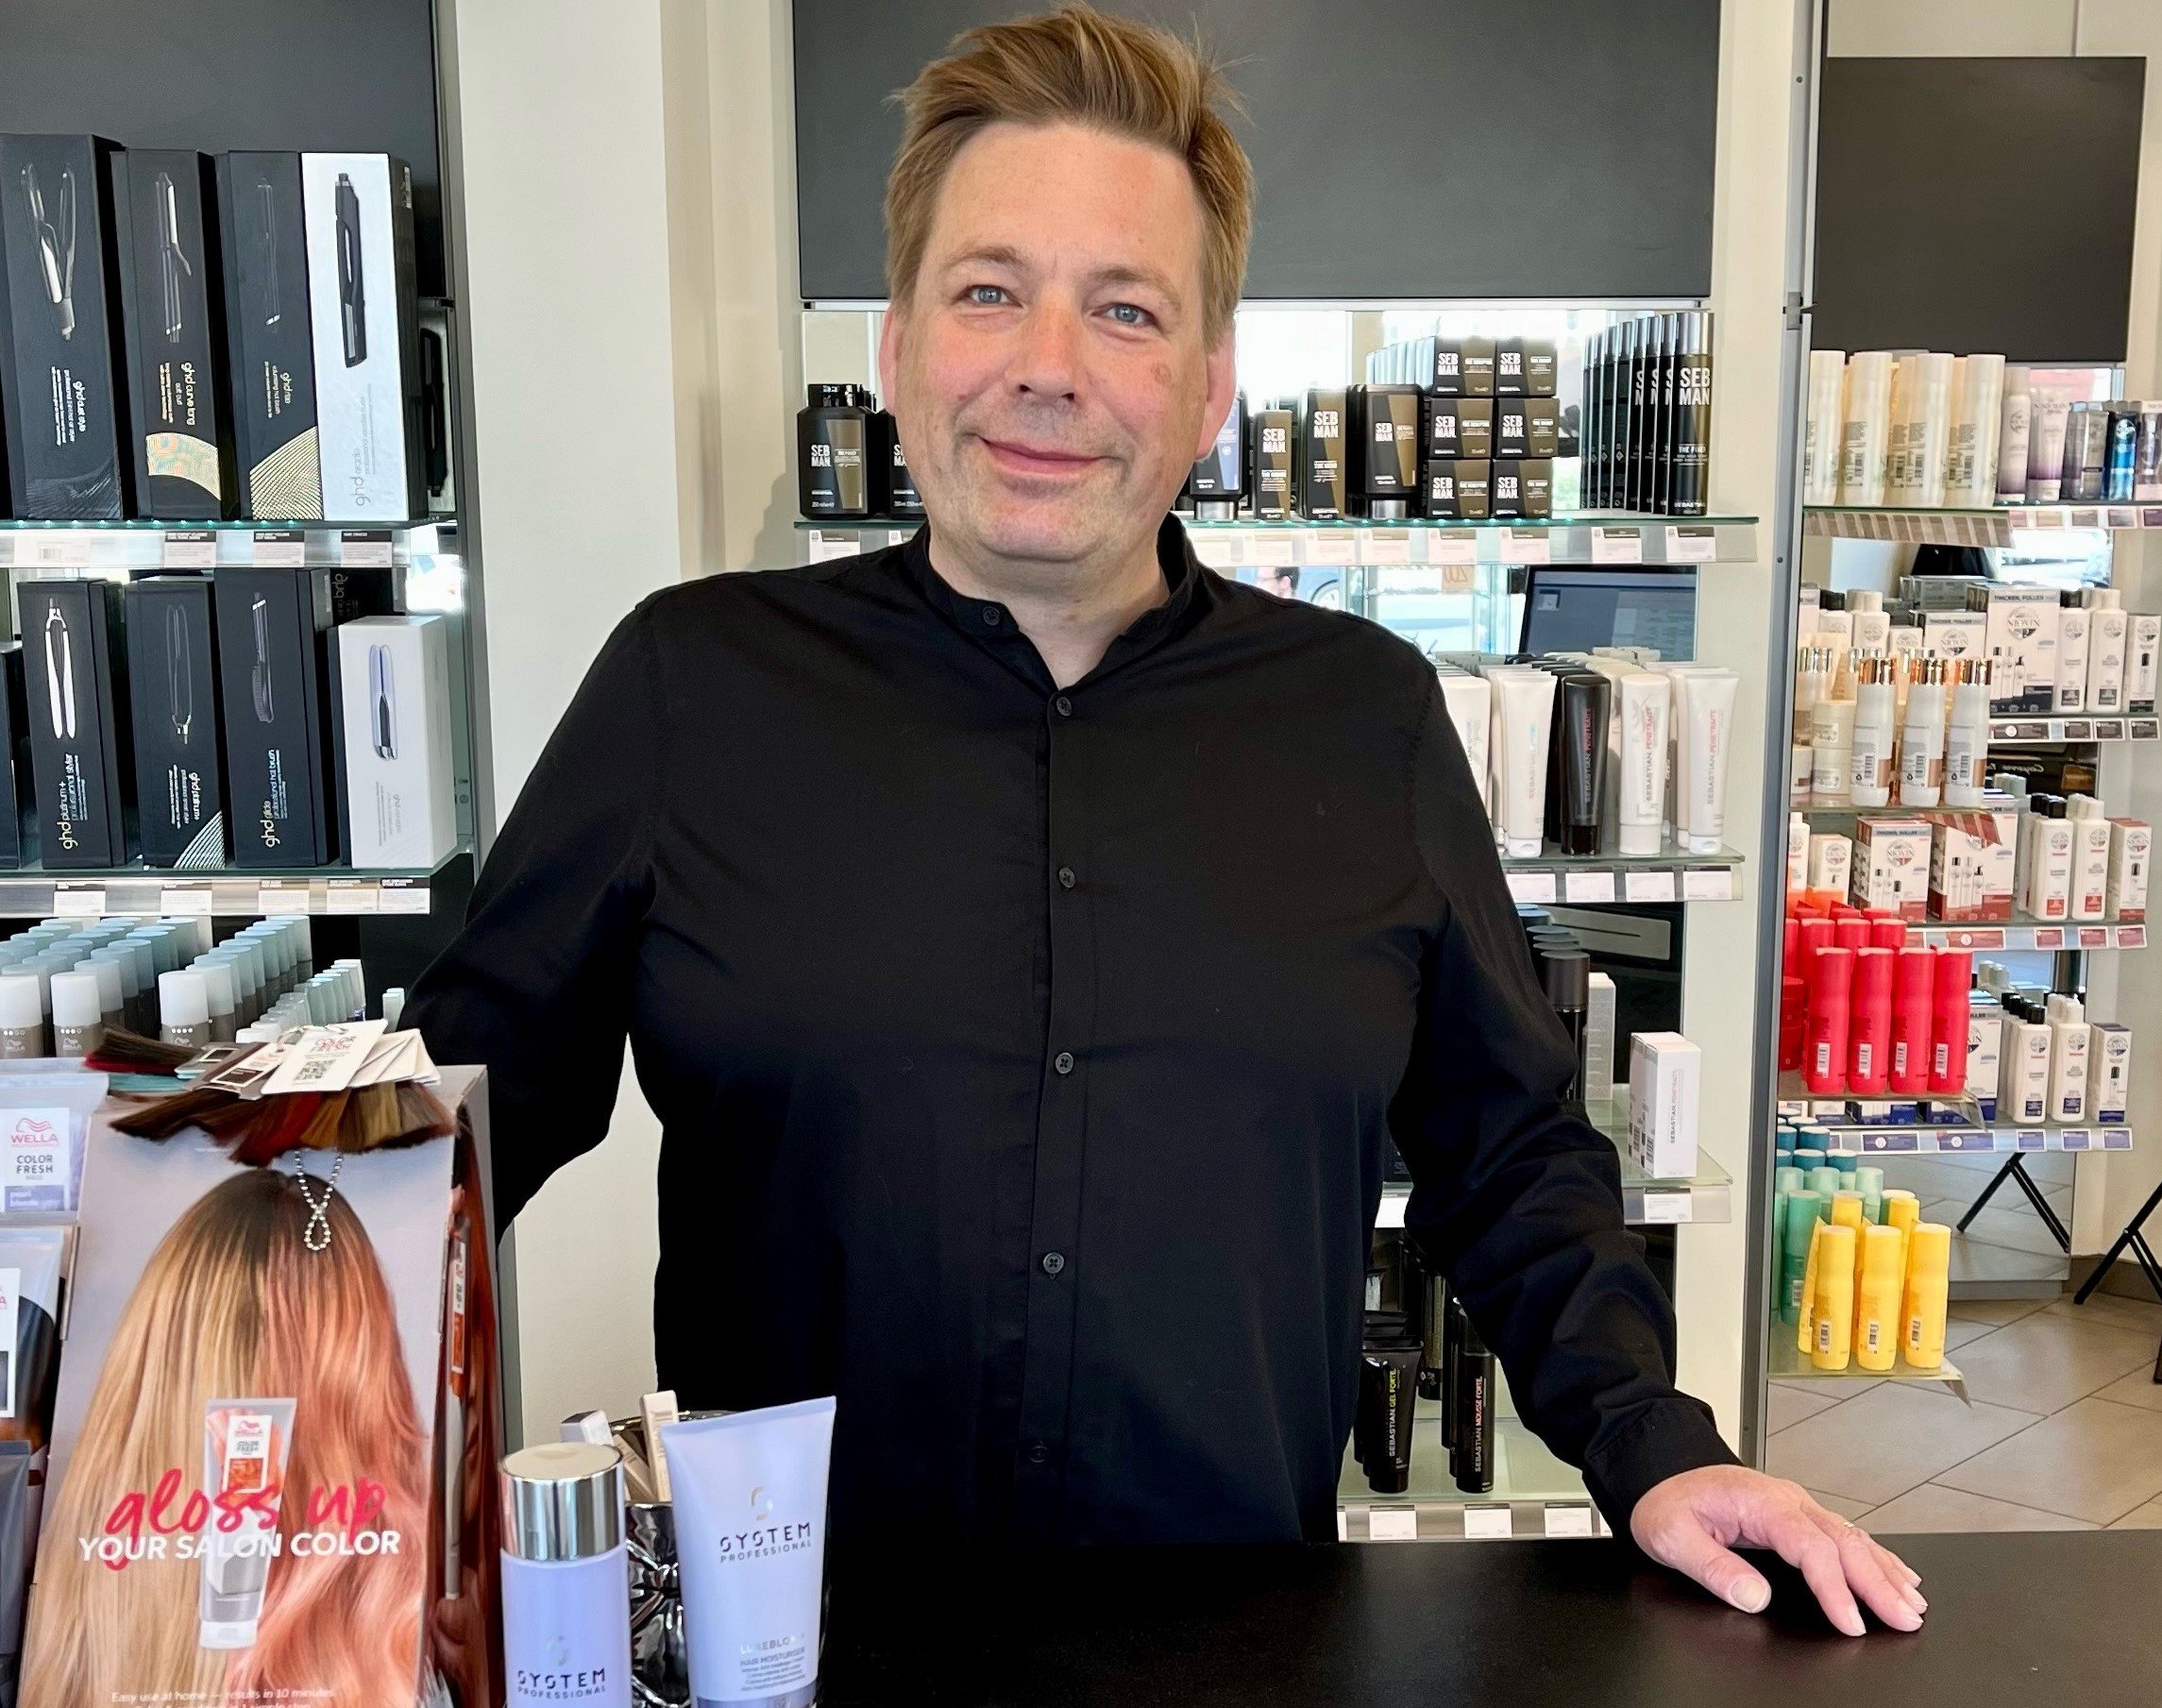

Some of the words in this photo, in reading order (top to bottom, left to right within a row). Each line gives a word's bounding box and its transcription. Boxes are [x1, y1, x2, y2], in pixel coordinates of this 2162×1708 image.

[1439, 353, 1458, 364] SEB
[1500, 353, 1520, 364] SEB
[181, 363, 195, 384] ghd
[1680, 367, 1711, 387] SEB
[1679, 388, 1711, 405] MAN
[1314, 412, 1339, 425] SEB
[1503, 415, 1523, 427] SEB
[1263, 429, 1286, 441] SEB
[811, 445, 830, 456] SEB
[811, 457, 831, 466] MAN
[1433, 478, 1453, 488] SEB
[1497, 477, 1518, 488] SEB
[350, 477, 371, 506] ghd
[189, 772, 201, 790] ghd
[57, 821, 78, 850] ghd
[260, 820, 280, 848] ghd
[11, 1133, 59, 1143] WELLA
[17, 1155, 53, 1163] COLOR
[17, 1165, 53, 1174] FRESH
[104, 1467, 280, 1571] gloss
[308, 1477, 385, 1546] up
[719, 1522, 811, 1552] SYSTEM
[78, 1536, 168, 1562] YOUR
[176, 1532, 282, 1560] SALON
[290, 1530, 401, 1557] COLOR
[720, 1539, 812, 1564] PROFESSIONAL
[517, 1667, 605, 1689] SYSTEM
[175, 1691, 208, 1700] home
[263, 1689, 274, 1699] in
[276, 1688, 290, 1699] 10
[517, 1684, 606, 1700] PROFESSIONAL
